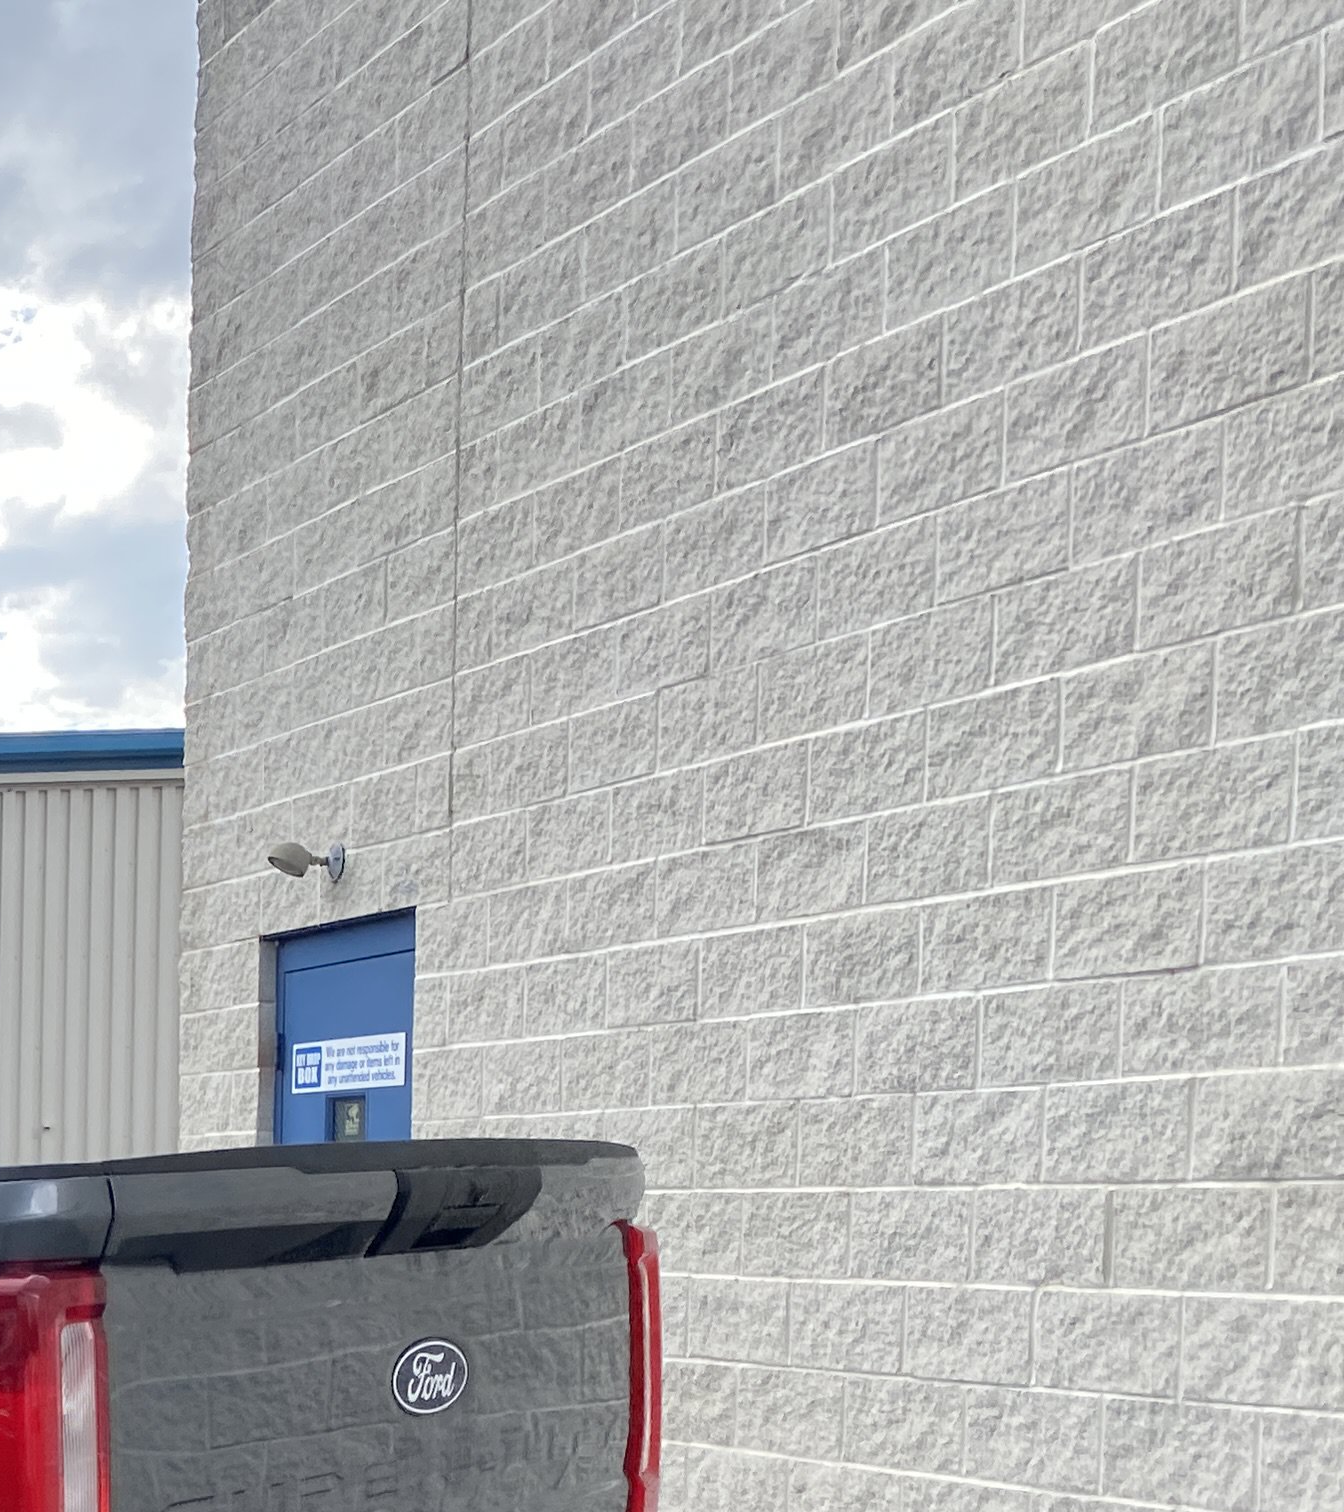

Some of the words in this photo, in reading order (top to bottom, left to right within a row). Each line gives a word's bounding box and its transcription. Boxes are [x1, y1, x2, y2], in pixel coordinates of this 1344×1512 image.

[326, 1046, 335, 1057] We
[336, 1048, 345, 1057] are
[346, 1045, 355, 1056] not
[356, 1040, 389, 1057] responsible
[391, 1040, 399, 1051] for
[325, 1062, 334, 1073] any
[336, 1059, 358, 1073] damage
[359, 1059, 365, 1068] or
[366, 1056, 382, 1068] items
[383, 1055, 393, 1066] left
[394, 1055, 400, 1066] in
[297, 1066, 318, 1085] BOX
[327, 1075, 337, 1087] any
[338, 1070, 370, 1084] unattended
[407, 1352, 457, 1403] Ford
